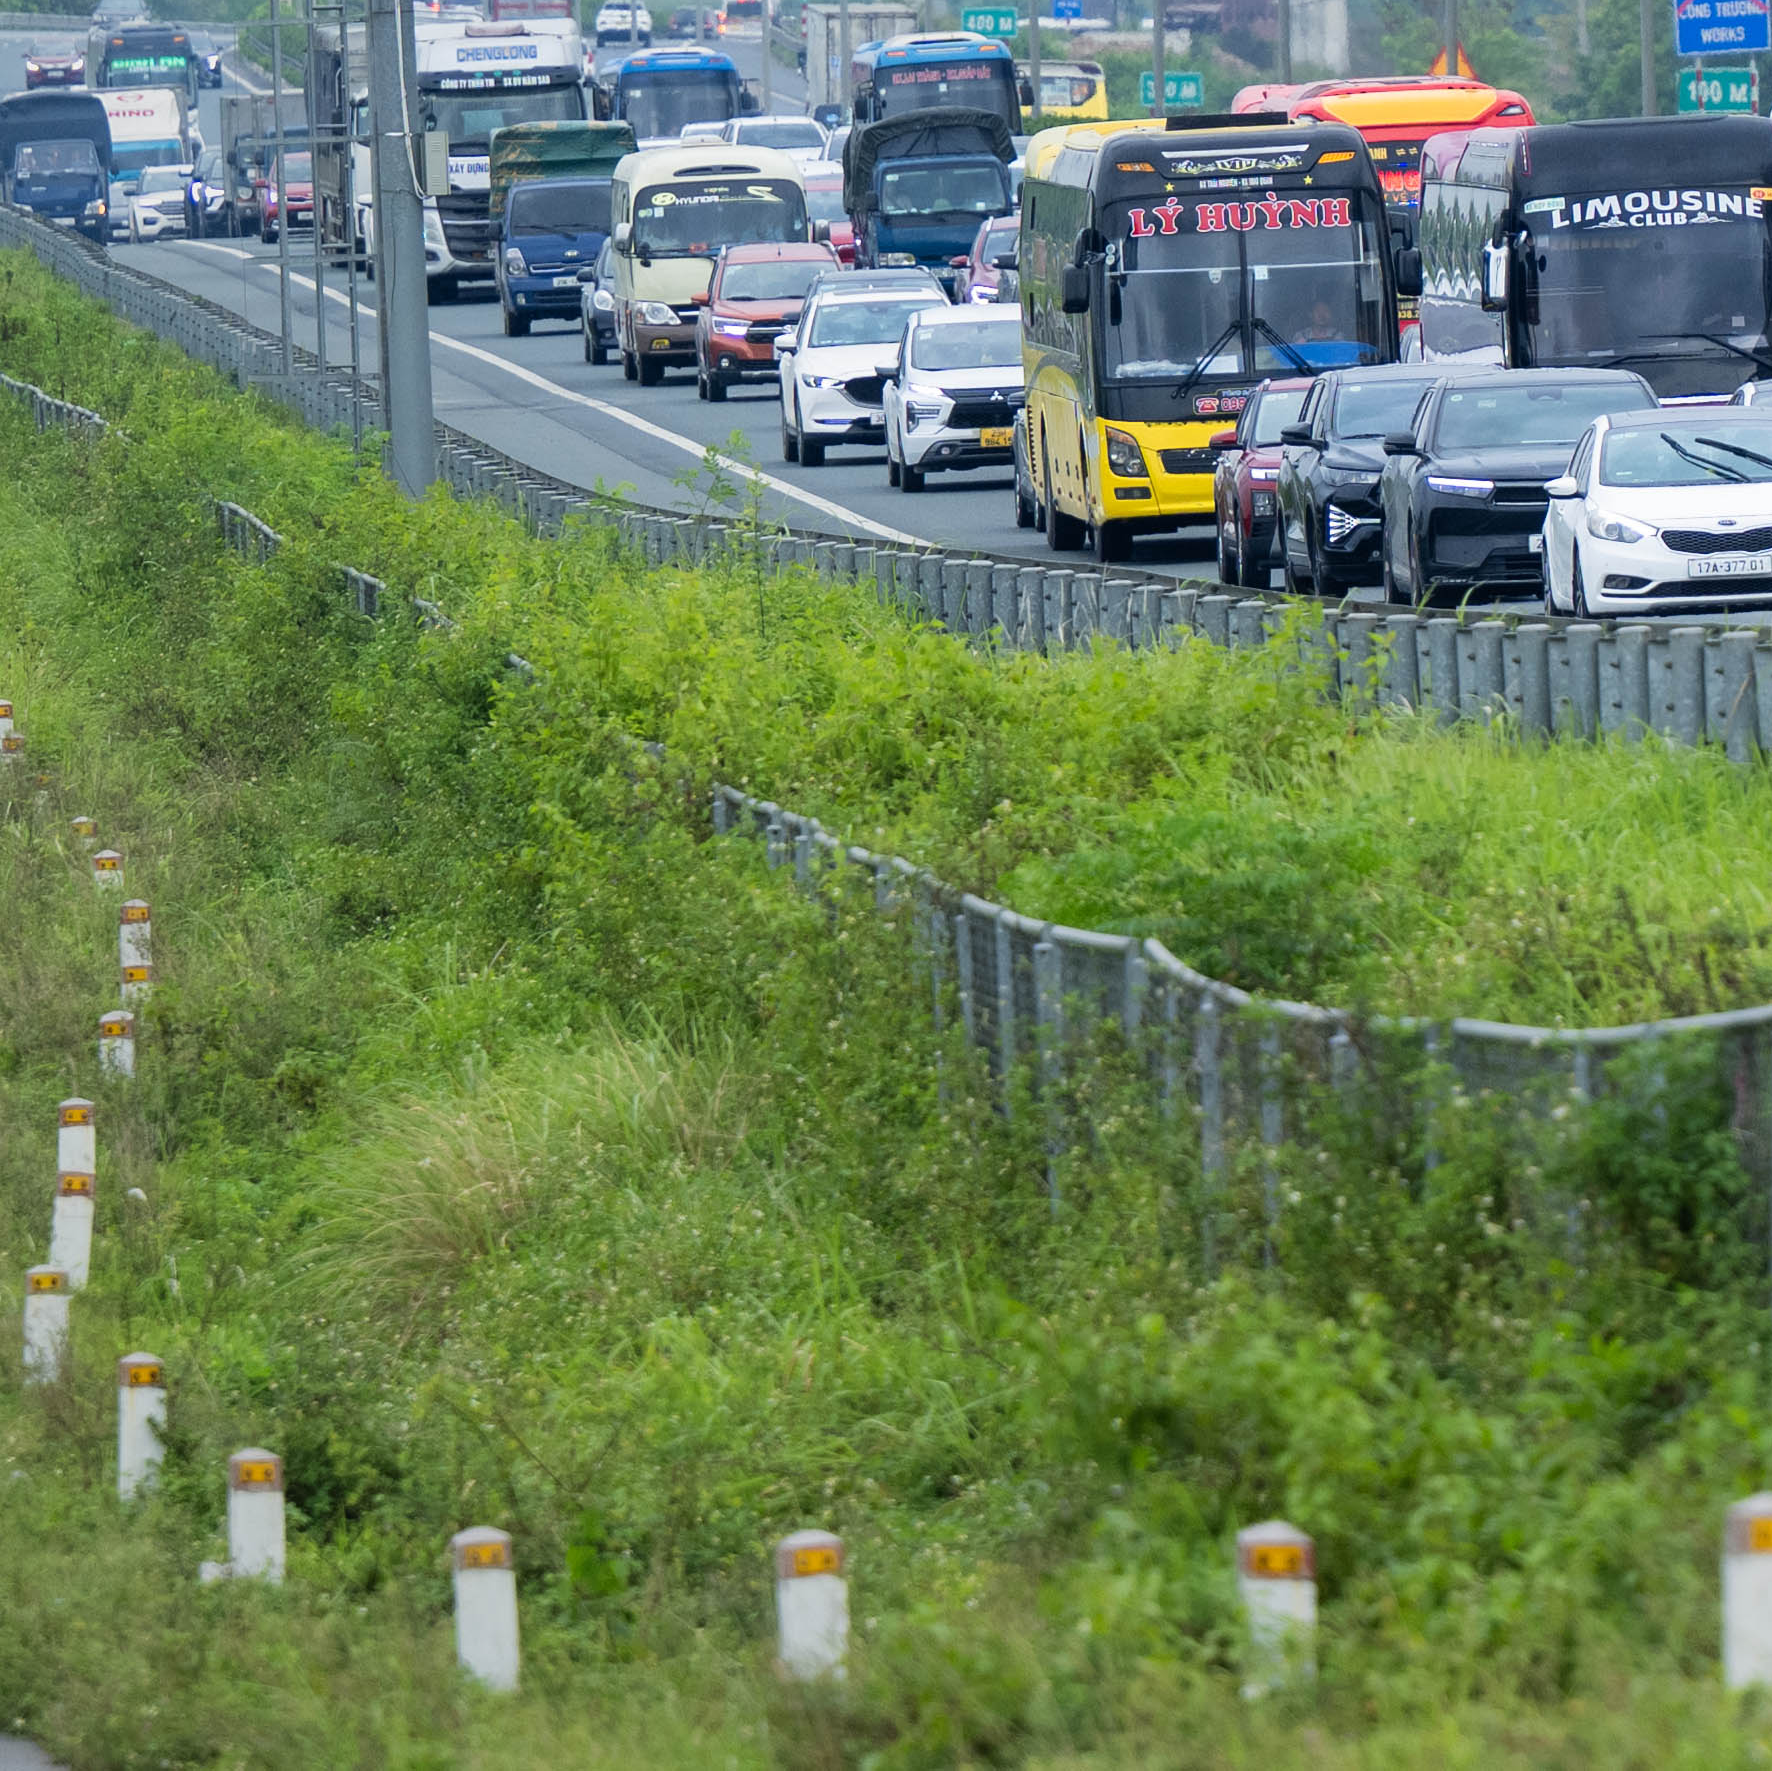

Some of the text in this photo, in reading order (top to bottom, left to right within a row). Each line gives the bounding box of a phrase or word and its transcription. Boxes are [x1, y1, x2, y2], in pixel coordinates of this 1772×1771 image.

[967, 14, 995, 31] 400
[1700, 26, 1746, 45] WORKS
[456, 45, 538, 63] CHENGLONG
[1687, 80, 1723, 104] 100
[108, 109, 155, 118] HINO
[1128, 190, 1352, 237] LÝ HUỲNH
[1551, 190, 1765, 229] LIMOUSINE
[1629, 213, 1688, 227] CLUB
